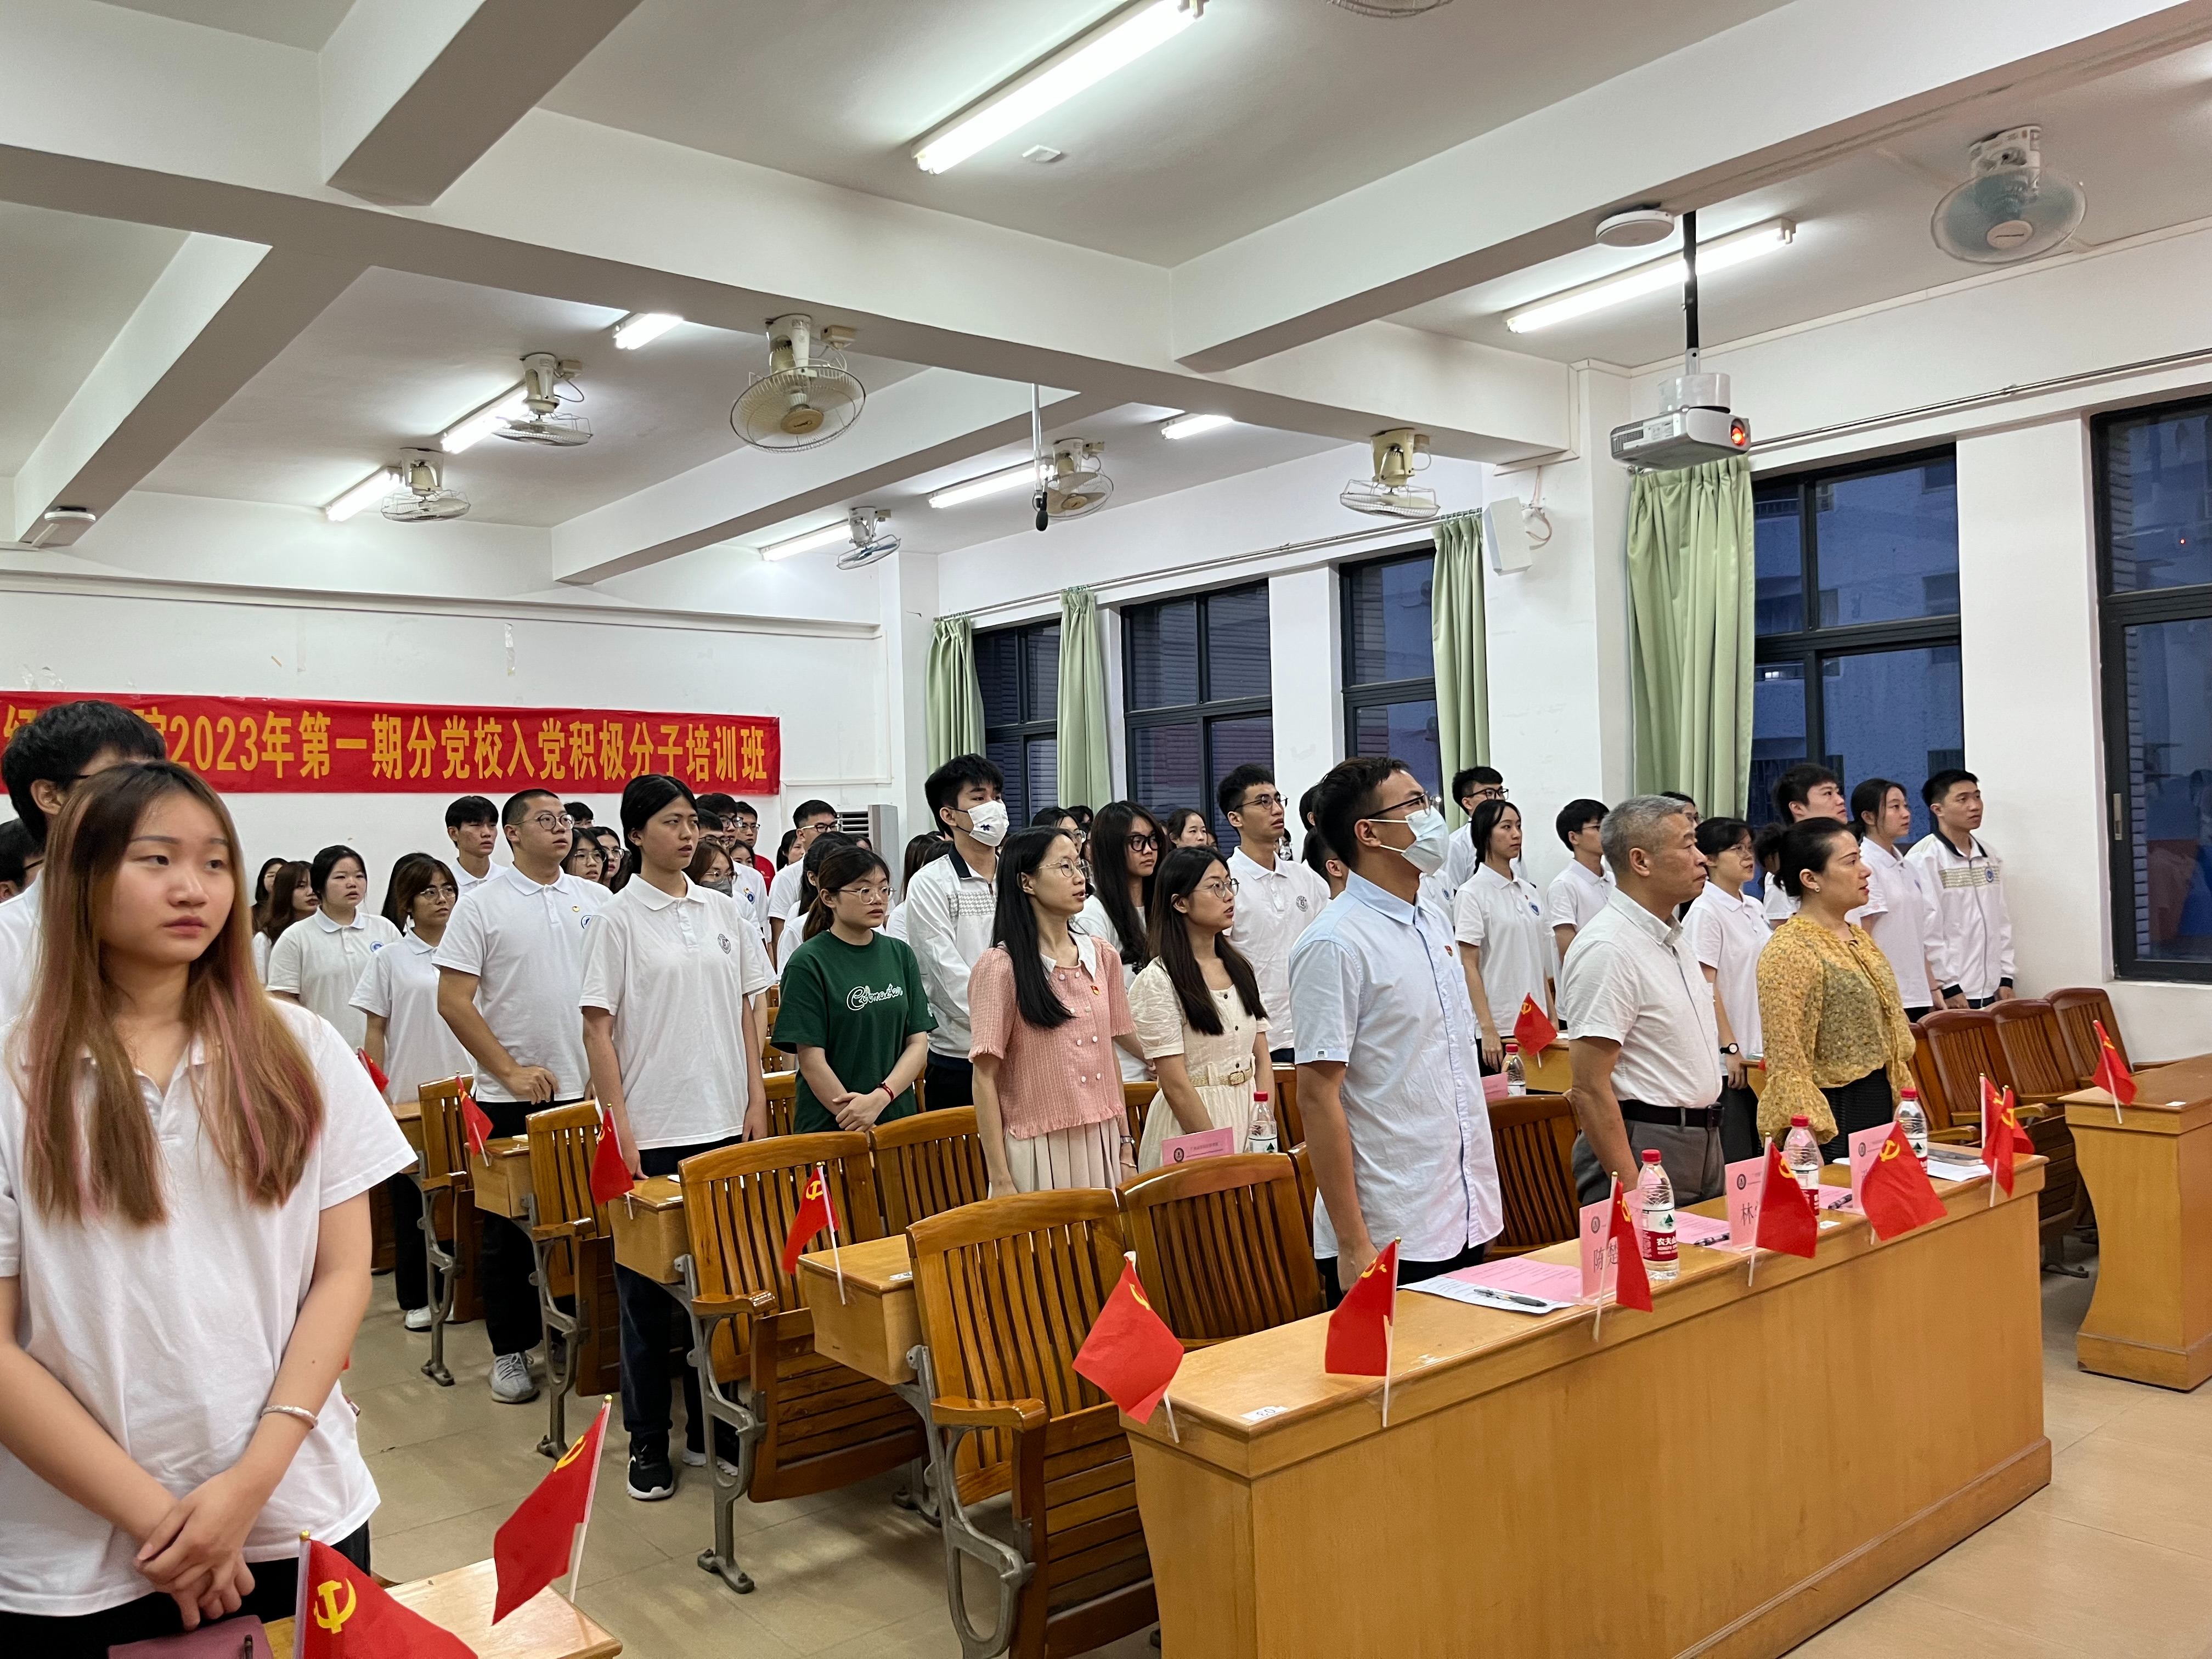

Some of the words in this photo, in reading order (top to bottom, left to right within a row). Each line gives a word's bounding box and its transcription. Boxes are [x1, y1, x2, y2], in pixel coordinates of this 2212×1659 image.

[4, 704, 767, 782] 2023年第一期分党校入党积极分子培训班
[1740, 1201, 1759, 1226] 林
